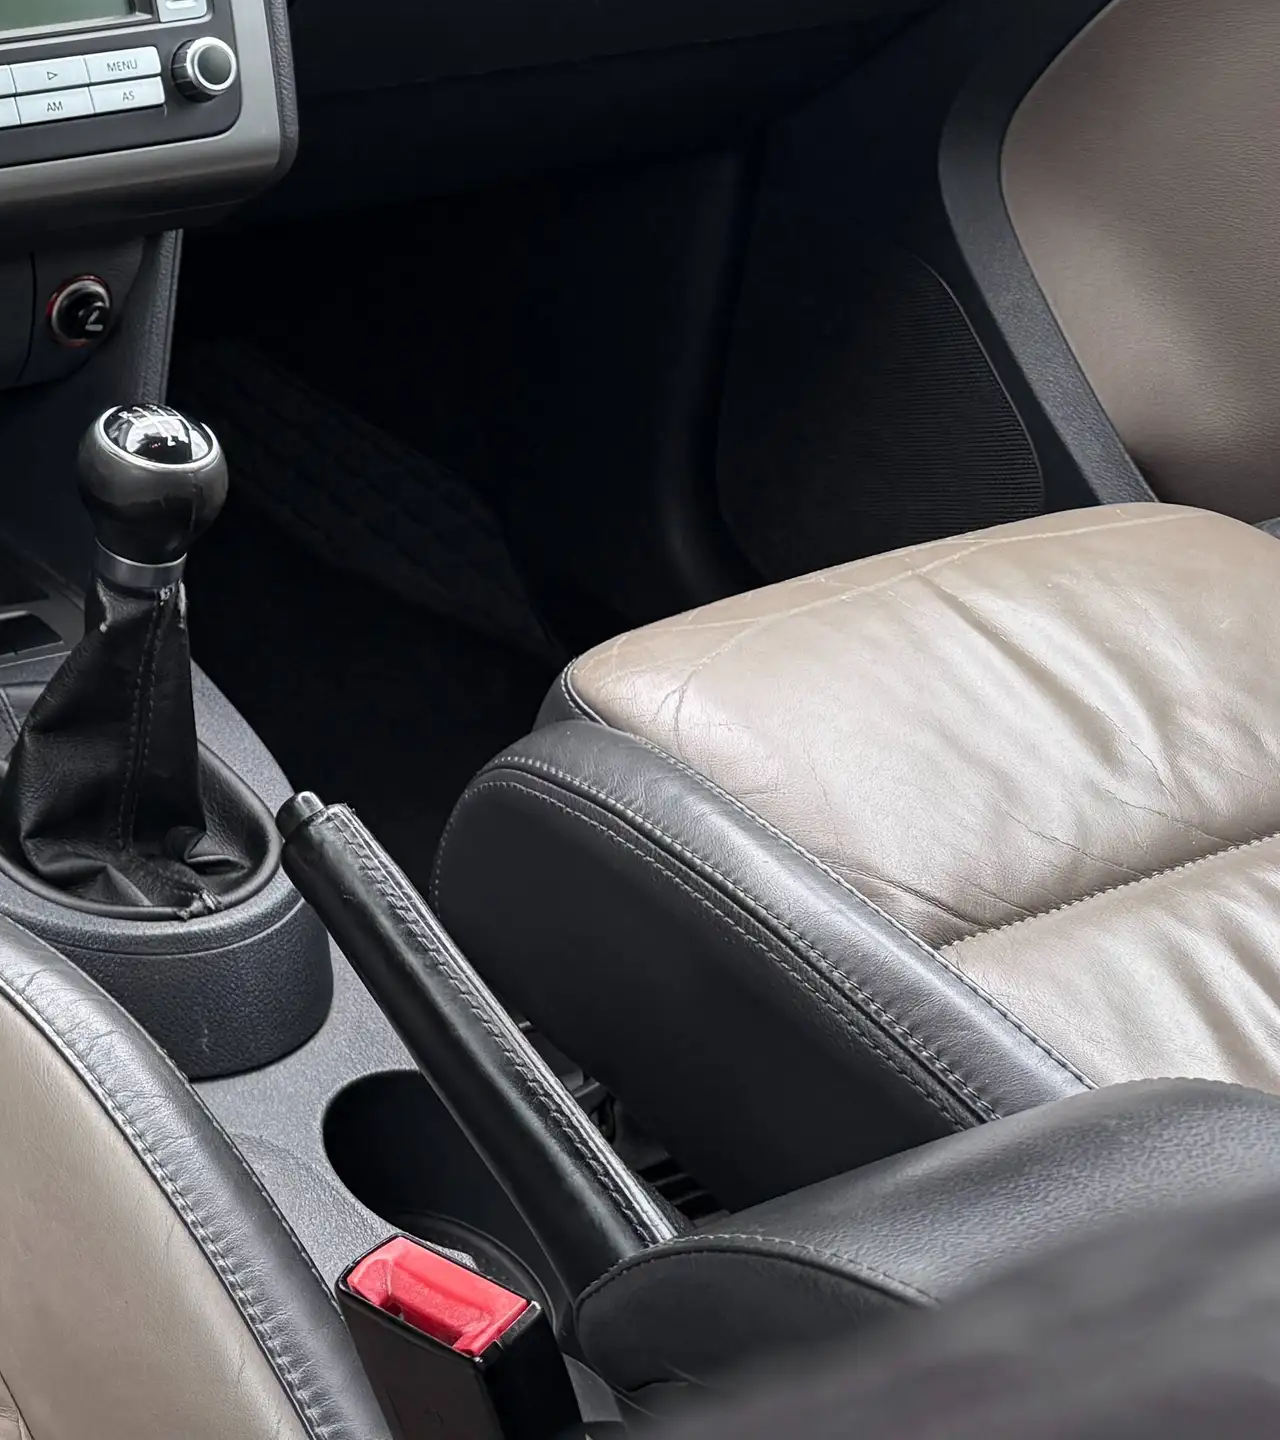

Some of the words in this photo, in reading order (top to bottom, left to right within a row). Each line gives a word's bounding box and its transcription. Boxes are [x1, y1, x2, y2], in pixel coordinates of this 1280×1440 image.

[106, 59, 138, 72] MENU
[122, 90, 136, 101] AS
[46, 100, 64, 113] AM
